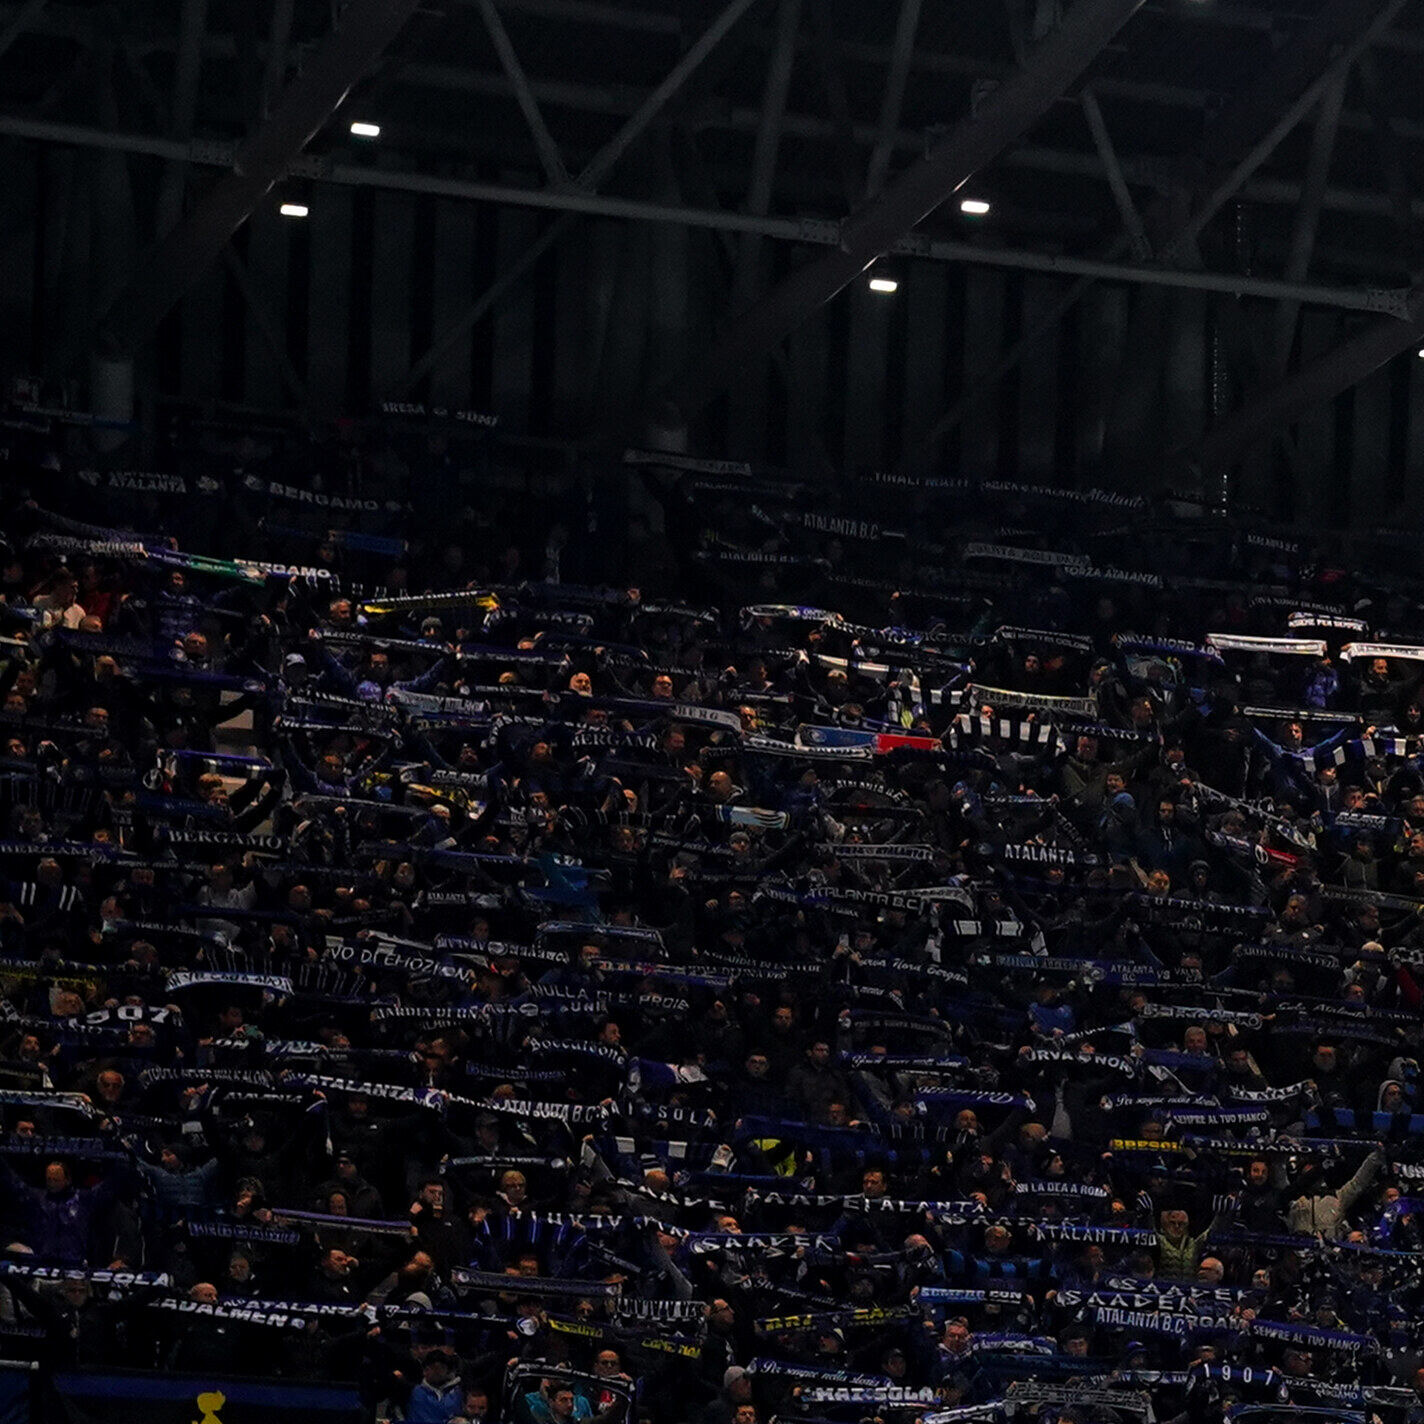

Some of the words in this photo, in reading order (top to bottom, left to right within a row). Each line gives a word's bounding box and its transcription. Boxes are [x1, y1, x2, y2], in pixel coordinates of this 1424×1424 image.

[271, 481, 378, 511] BERGAMO
[1004, 843, 1075, 863] ATALANTA
[1110, 964, 1153, 976] ATALANTA
[1174, 1114, 1205, 1123] SEMPRE
[1221, 1114, 1237, 1122] TUO
[1238, 1113, 1267, 1122] FIANCO
[1096, 1307, 1158, 1329] ATALANTA
[1253, 1325, 1290, 1341] SEMPRE
[1292, 1333, 1304, 1343] AL
[1305, 1335, 1323, 1346] TUO
[1325, 1338, 1361, 1352] FIANCO
